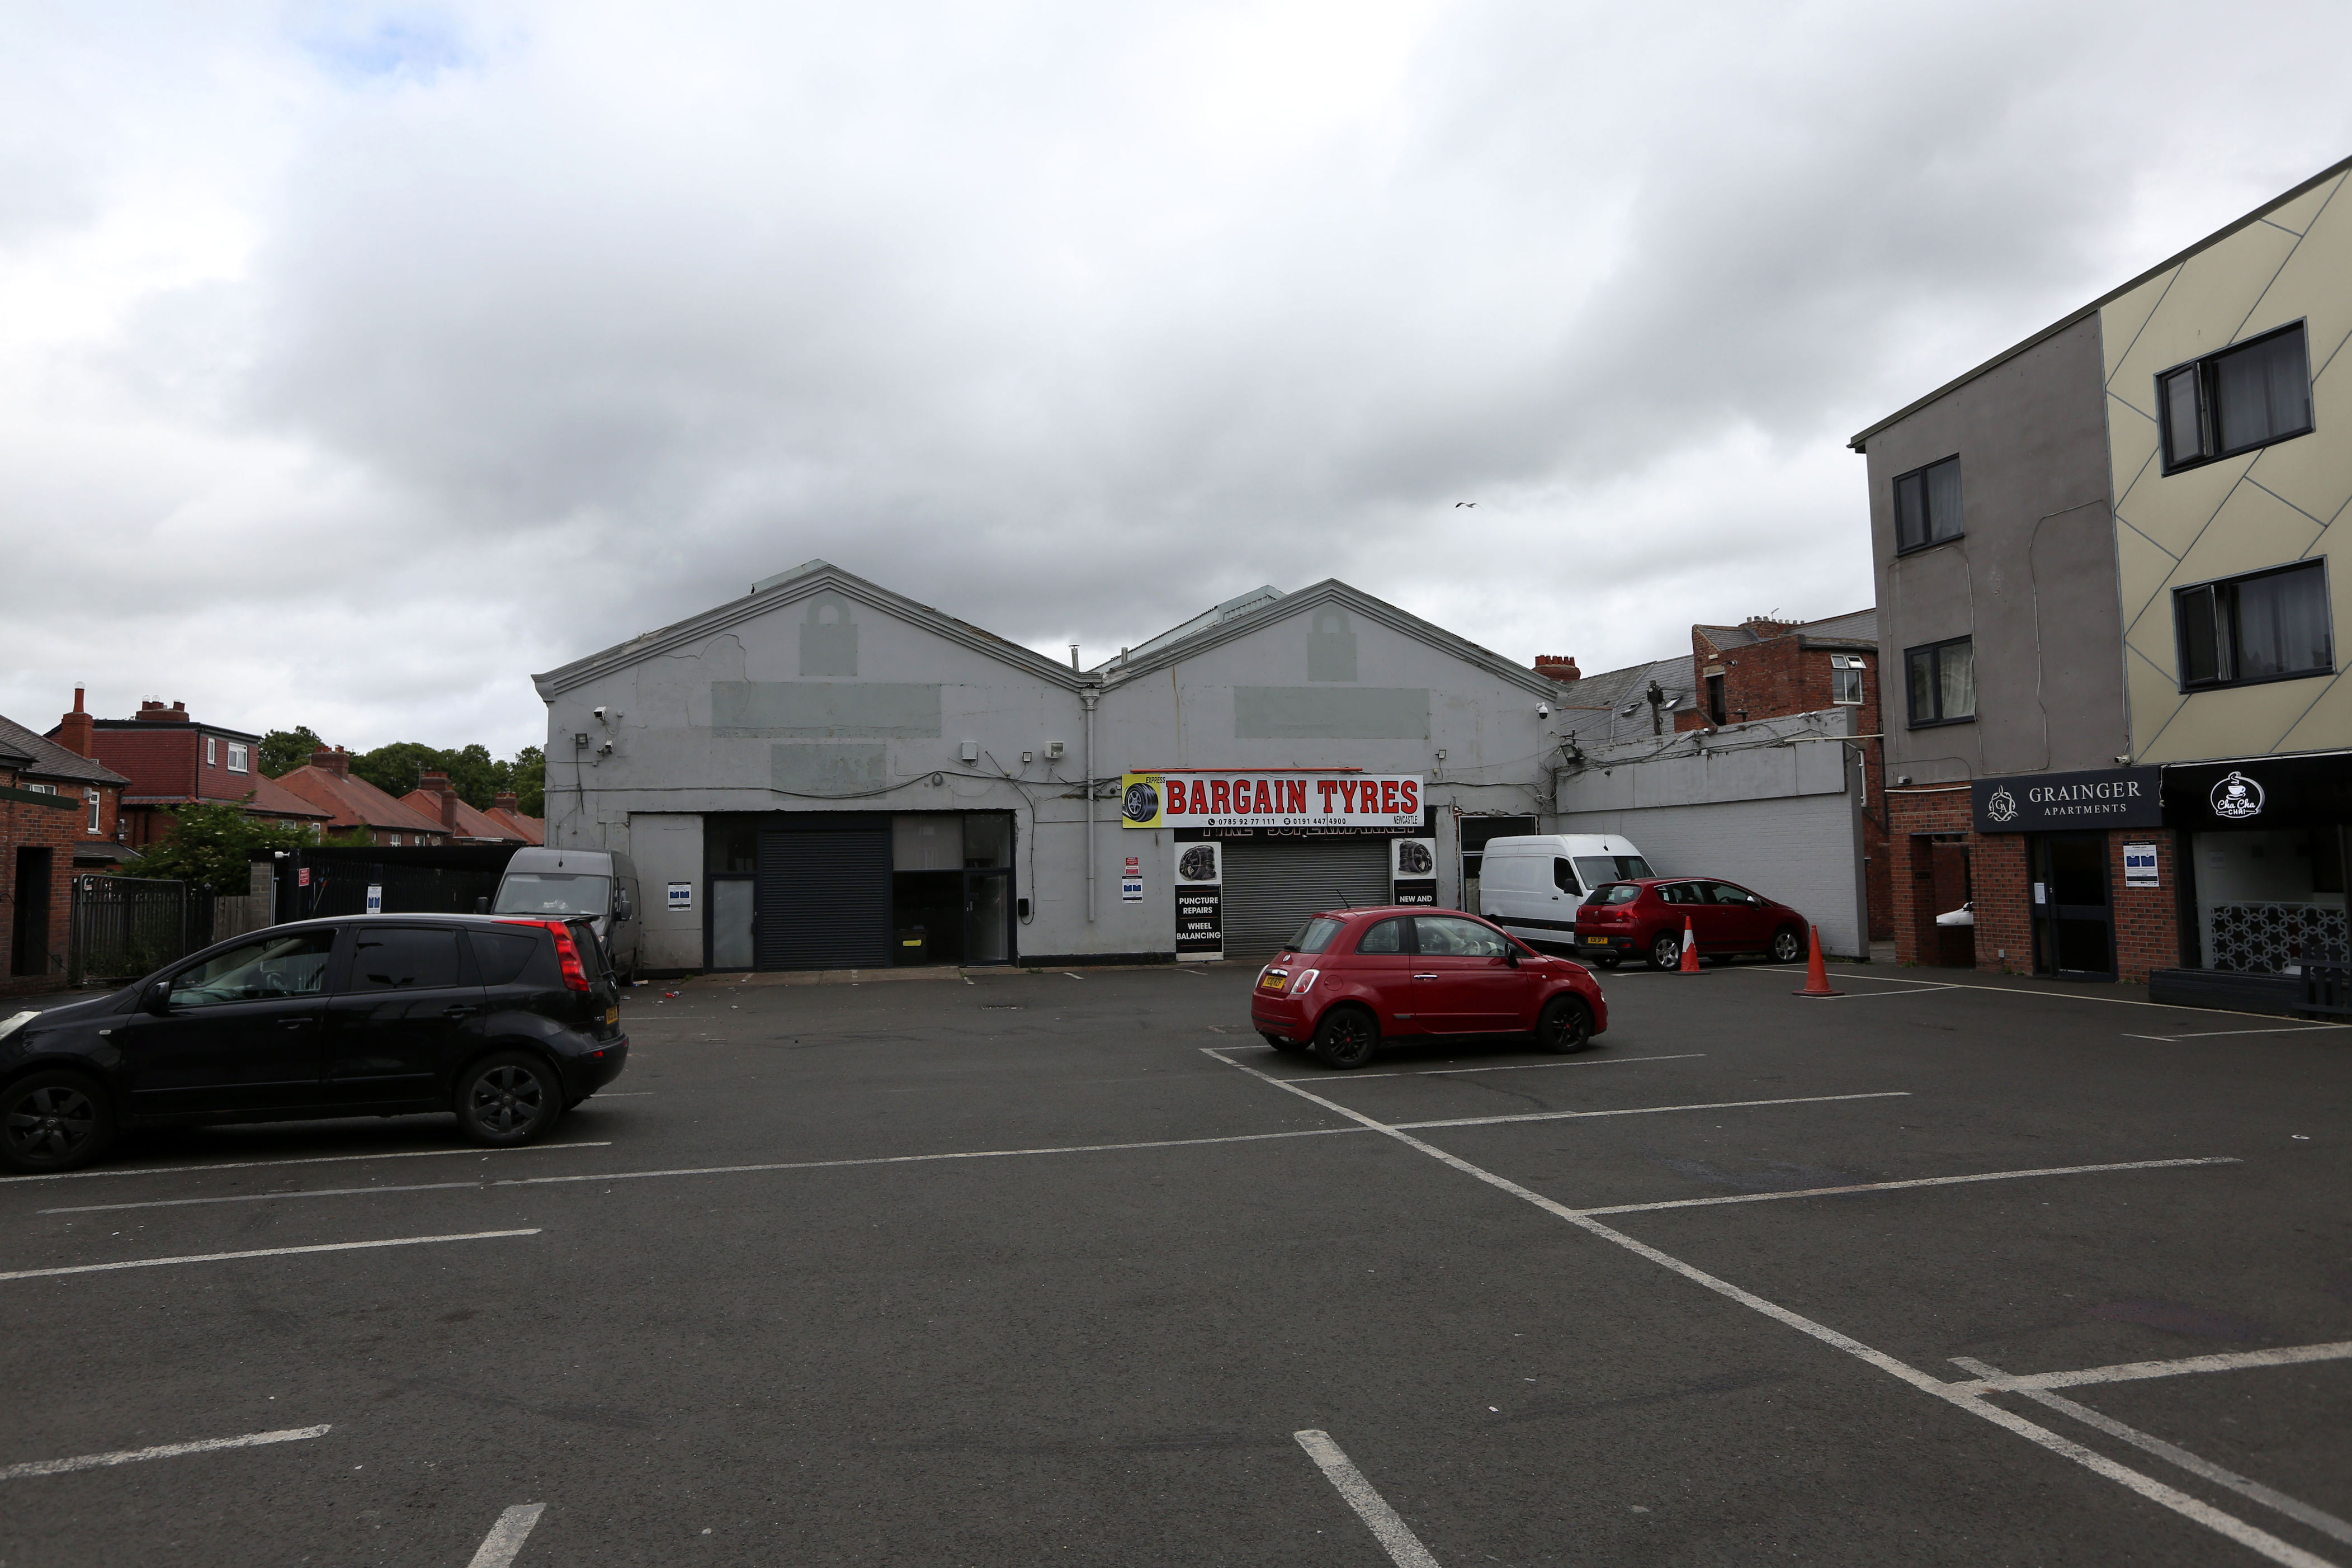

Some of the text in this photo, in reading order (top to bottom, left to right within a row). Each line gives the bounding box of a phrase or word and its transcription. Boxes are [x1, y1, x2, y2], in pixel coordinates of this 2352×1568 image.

[1166, 780, 1418, 814] BARGAIN TYRES
[2029, 781, 2142, 802] GRAINGER
[2044, 804, 2126, 816] APARTMENTS
[2217, 799, 2255, 810] Cha Cha
[1394, 815, 1418, 824] NEWCASTLE
[1179, 896, 1218, 905] PUNCTURE
